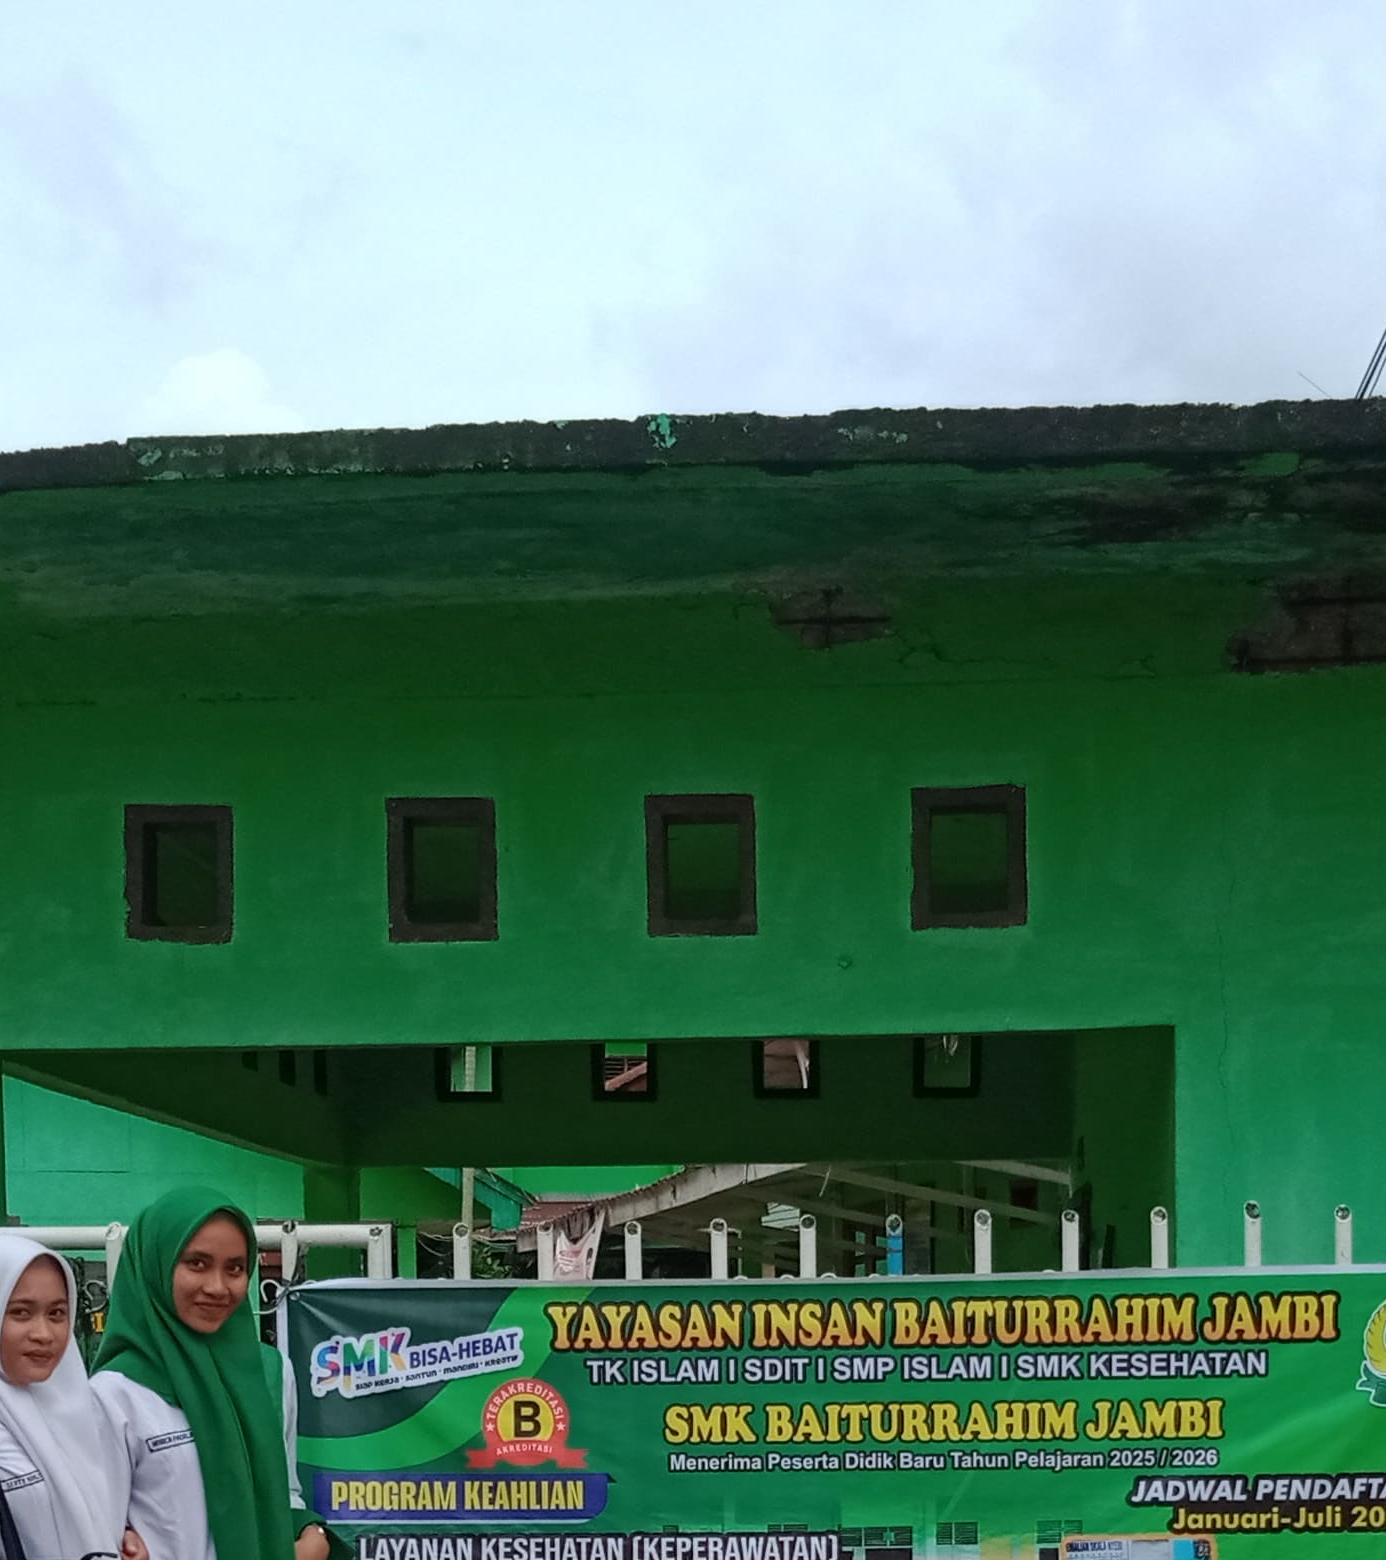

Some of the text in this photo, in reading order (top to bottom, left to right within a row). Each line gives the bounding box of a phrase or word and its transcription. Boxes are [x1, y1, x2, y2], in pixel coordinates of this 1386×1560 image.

[548, 1295, 1338, 1348] YAYASAN INSAN BAITURRAHIM JAMBI
[316, 1333, 406, 1391] SMK
[409, 1333, 518, 1368] BISA-HEBAT
[587, 1360, 625, 1383] TK
[633, 1358, 719, 1383] ISLAM
[744, 1358, 809, 1382] SDIT
[833, 1357, 894, 1381] SMP
[903, 1356, 991, 1380] ISLAM
[1016, 1354, 1081, 1378] SMK
[1090, 1352, 1266, 1377] KESEHATAN
[486, 1382, 564, 1420] TERAKREDITASI
[514, 1401, 541, 1438] B
[666, 1400, 1224, 1442] SMK BAITURRAHIM JAMBI
[496, 1443, 553, 1456] AKREDITASI
[670, 1455, 762, 1471] Menerima
[768, 1454, 839, 1470] Peserta
[846, 1452, 893, 1469] Didik
[900, 1453, 944, 1469] Baru
[951, 1452, 1008, 1468] Tahun
[1015, 1452, 1103, 1472] Pelajaran
[1111, 1450, 1156, 1467] 2025
[1171, 1450, 1218, 1466] 2026
[331, 1480, 584, 1511] PROGRAM KEAHLIAN
[1132, 1480, 1247, 1502] JADWAL
[1173, 1506, 1341, 1529] Januari-Juli
